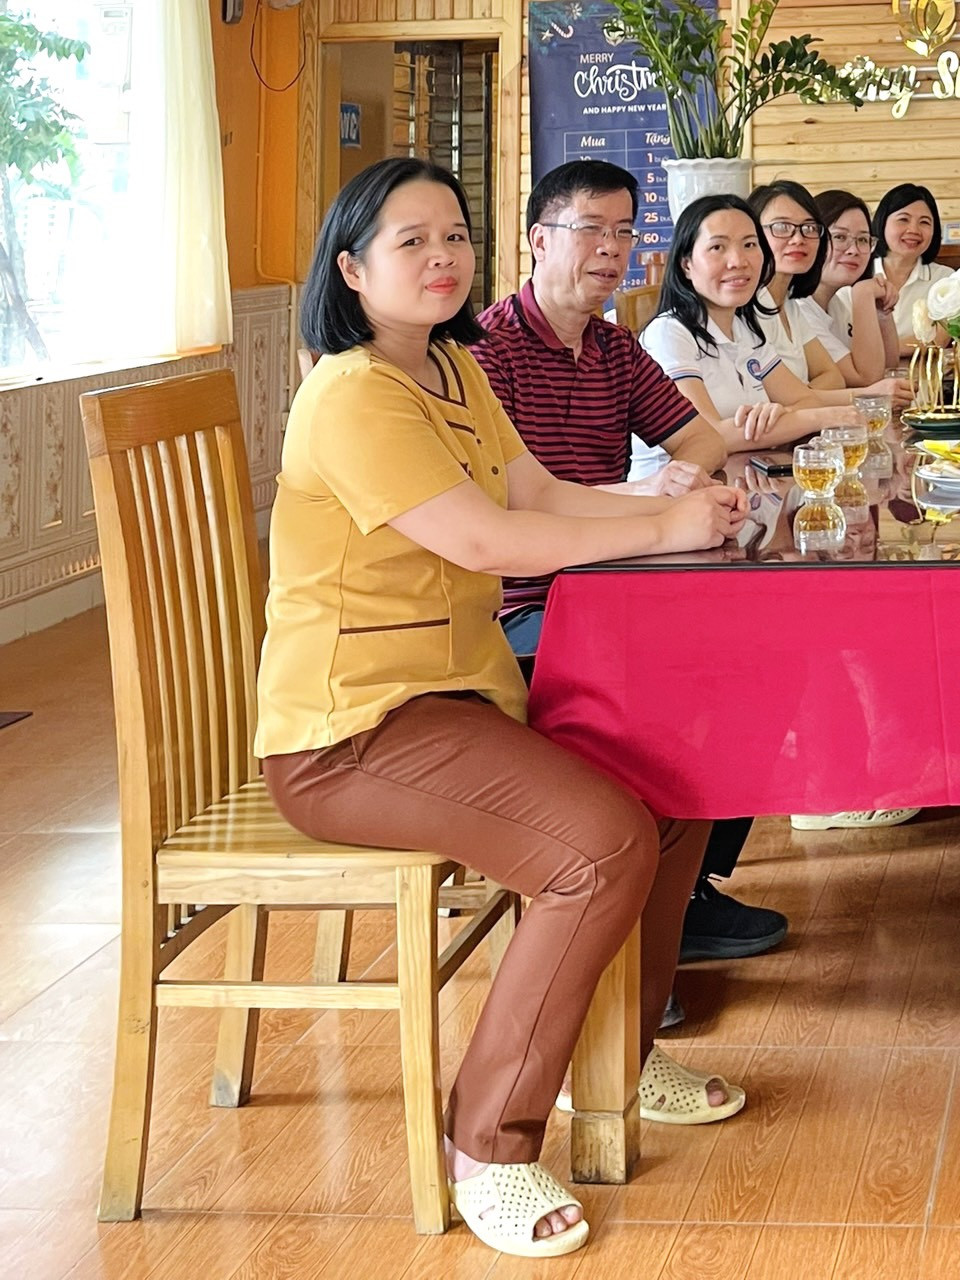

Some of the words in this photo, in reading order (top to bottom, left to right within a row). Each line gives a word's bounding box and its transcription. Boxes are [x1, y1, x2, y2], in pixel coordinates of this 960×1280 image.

[580, 52, 615, 64] MERRY
[583, 106, 600, 115] AND
[601, 106, 626, 114] HAPPY
[647, 103, 667, 111] YEAR
[580, 136, 606, 148] Mua
[647, 153, 653, 163] 1
[647, 172, 655, 183] 5
[644, 192, 657, 203] 10
[643, 212, 659, 223] 25
[643, 232, 659, 244] 60
